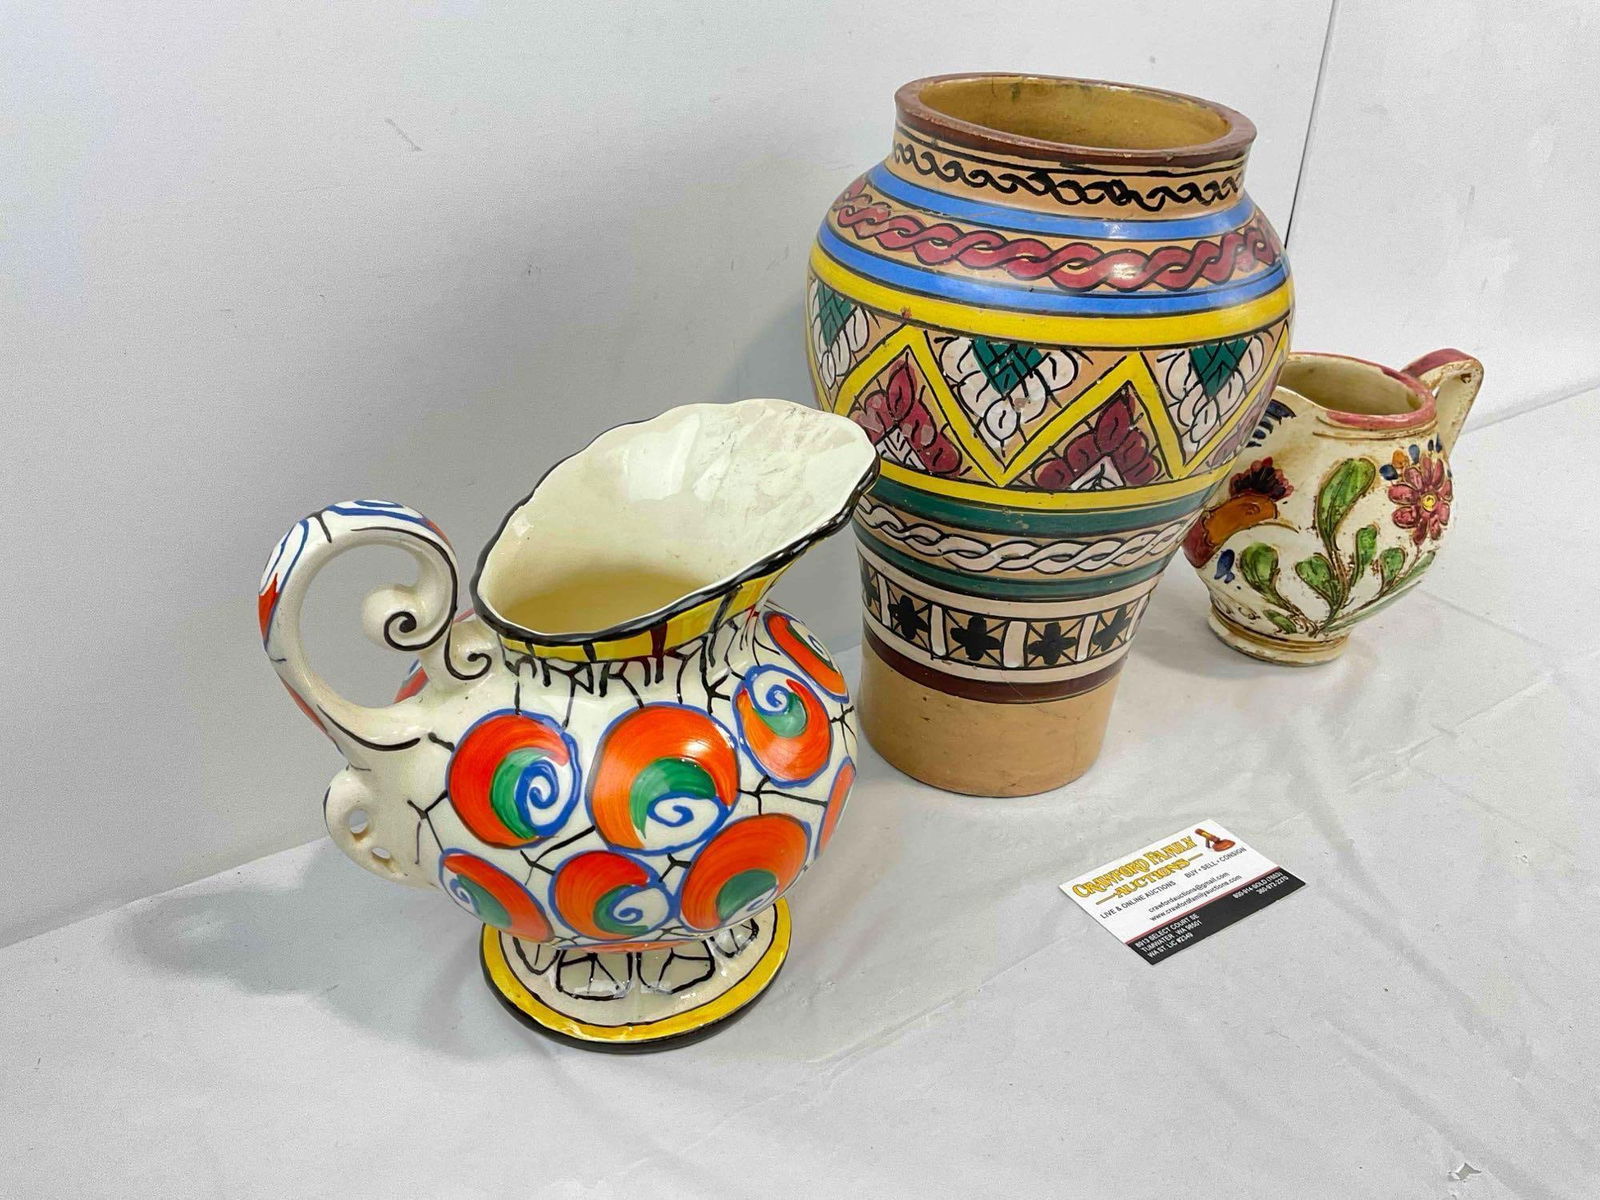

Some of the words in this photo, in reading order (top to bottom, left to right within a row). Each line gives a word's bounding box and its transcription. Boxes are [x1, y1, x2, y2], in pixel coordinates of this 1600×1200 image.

[1072, 857, 1150, 899] CRAWFORD
[1143, 836, 1199, 866] FAMILY
[1113, 857, 1191, 898] AUCTIONS
[1183, 869, 1199, 878] BUY
[1200, 860, 1218, 870] SELL
[1217, 846, 1247, 862] CONSIGN
[1099, 908, 1117, 919] LIVE
[1116, 904, 1124, 912] &
[1121, 894, 1146, 908] ONLINE
[1143, 880, 1177, 897] AUCTIONS
[1148, 872, 1230, 912] crawfordauctions@gmail.com
[1150, 875, 1242, 921] www.crawfordfamilyauctions.com
[1147, 927, 1172, 941] SELECT
[1169, 917, 1191, 930] COURT
[1148, 947, 1160, 958] WA
[1165, 939, 1179, 948] LIC
[1174, 927, 1188, 935] WA
